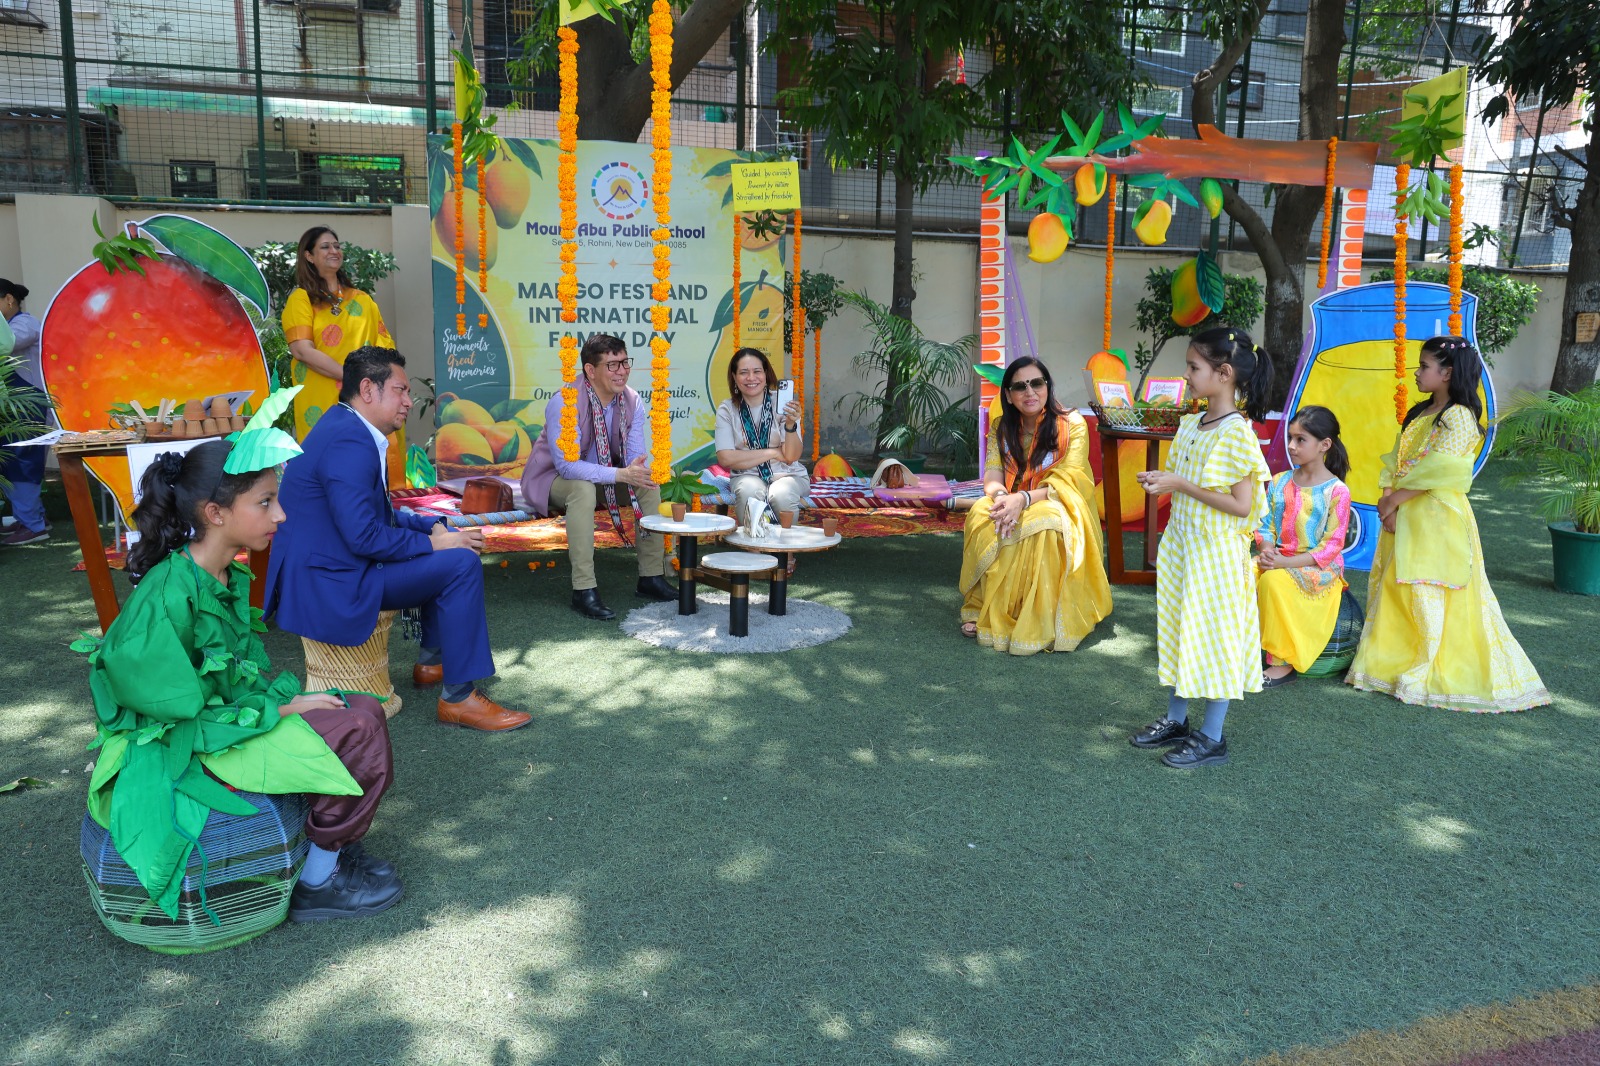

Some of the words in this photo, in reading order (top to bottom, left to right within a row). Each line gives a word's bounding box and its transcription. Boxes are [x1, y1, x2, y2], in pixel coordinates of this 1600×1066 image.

[764, 168, 771, 178] by
[767, 181, 773, 190] by
[764, 191, 770, 202] by
[526, 221, 568, 236] Mou
[577, 223, 607, 237] Abu
[664, 225, 705, 239] chool
[552, 238, 576, 247] Sect
[578, 239, 586, 248] 5,
[587, 239, 614, 248] Rohini,
[615, 240, 634, 249] New
[634, 240, 654, 248] Delhi
[529, 306, 698, 324] INTRNATIOAL
[443, 325, 473, 342] Swet
[443, 336, 489, 356] Moments
[447, 351, 476, 367] Great
[448, 365, 496, 381] Memories
